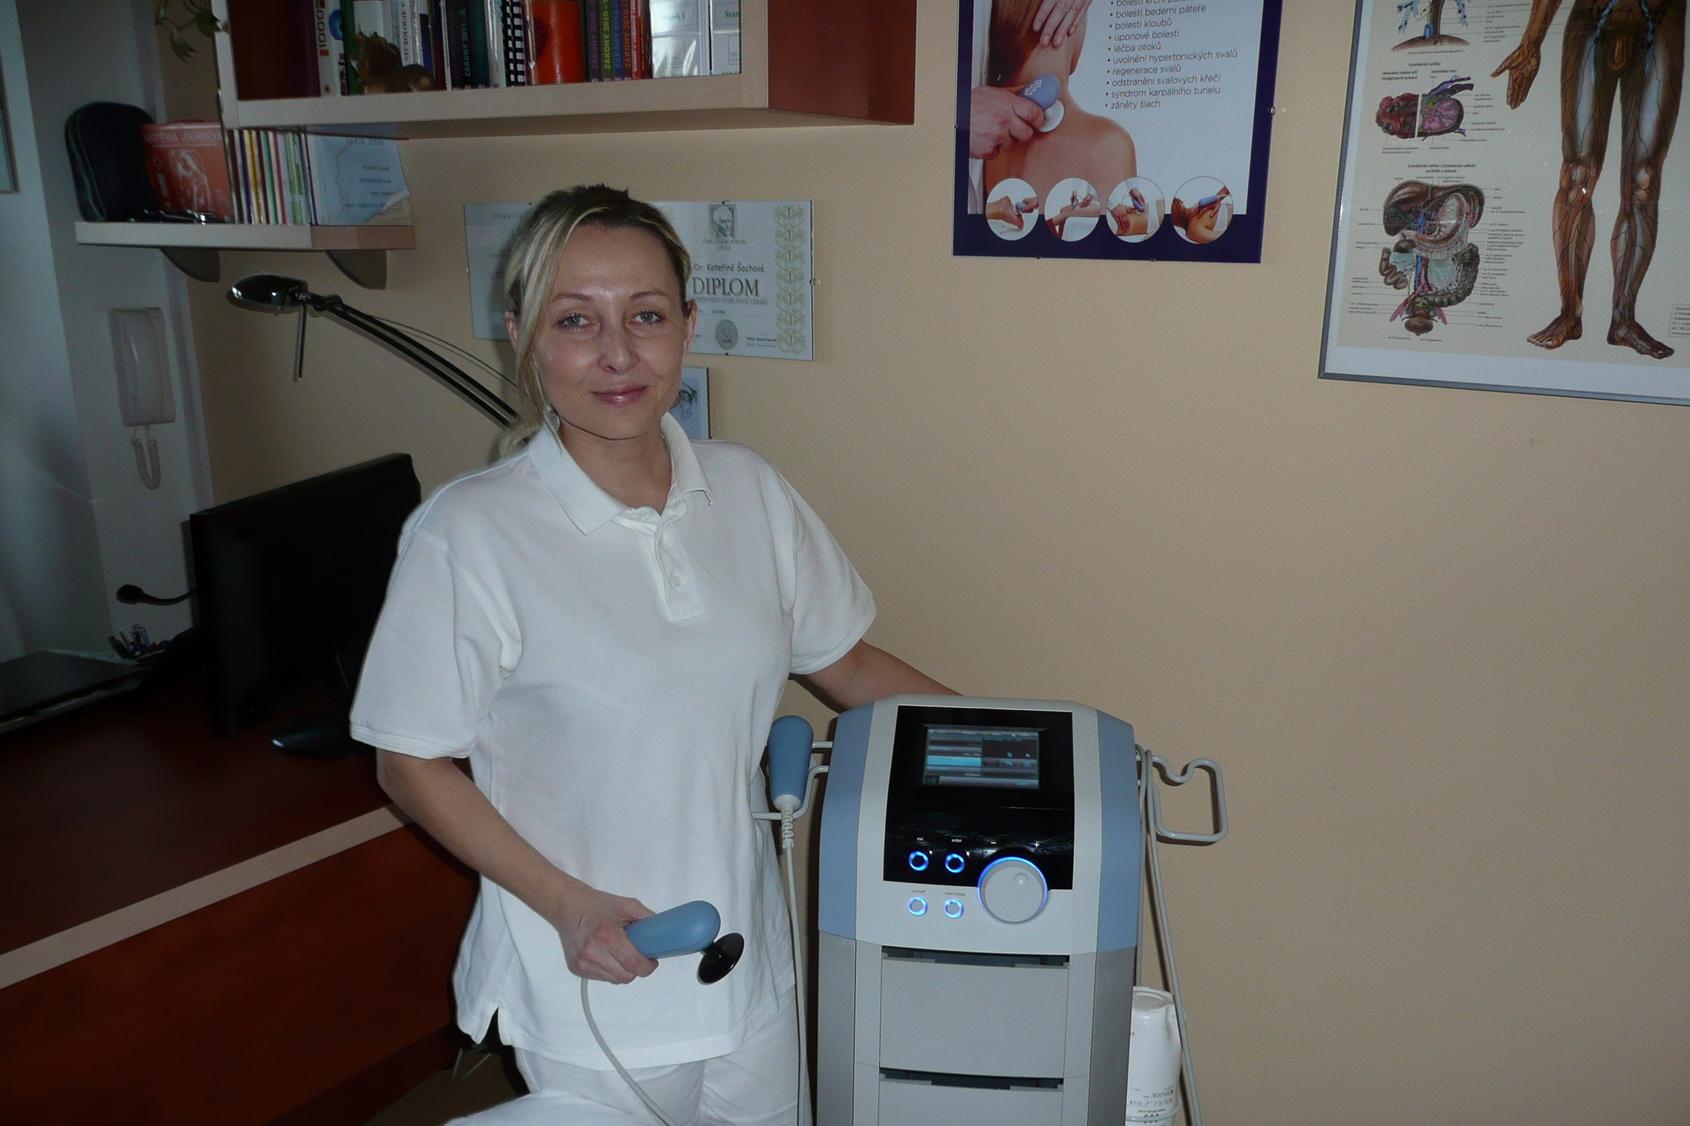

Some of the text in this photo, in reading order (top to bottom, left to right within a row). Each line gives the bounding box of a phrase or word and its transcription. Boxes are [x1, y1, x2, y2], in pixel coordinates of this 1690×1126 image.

[1115, 4, 1207, 18] bolesti bederní páteře
[602, 11, 610, 32] 2010
[1115, 17, 1172, 30] bolesti kloubů
[316, 10, 327, 48] 1000
[1152, 30, 1180, 39] bolesti
[601, 34, 611, 70] ZÁKONY
[1137, 41, 1162, 51] otoků
[1149, 50, 1213, 64] hypertonických
[1215, 48, 1238, 59] svalů
[1112, 63, 1182, 77] regenerace svalů
[1111, 77, 1155, 87] odstranění
[1157, 75, 1198, 86] svalových
[1111, 85, 1221, 99] syndrom karpálního tunelu
[1110, 99, 1161, 111] záněty šlach
[693, 278, 759, 296] DIPLOM
